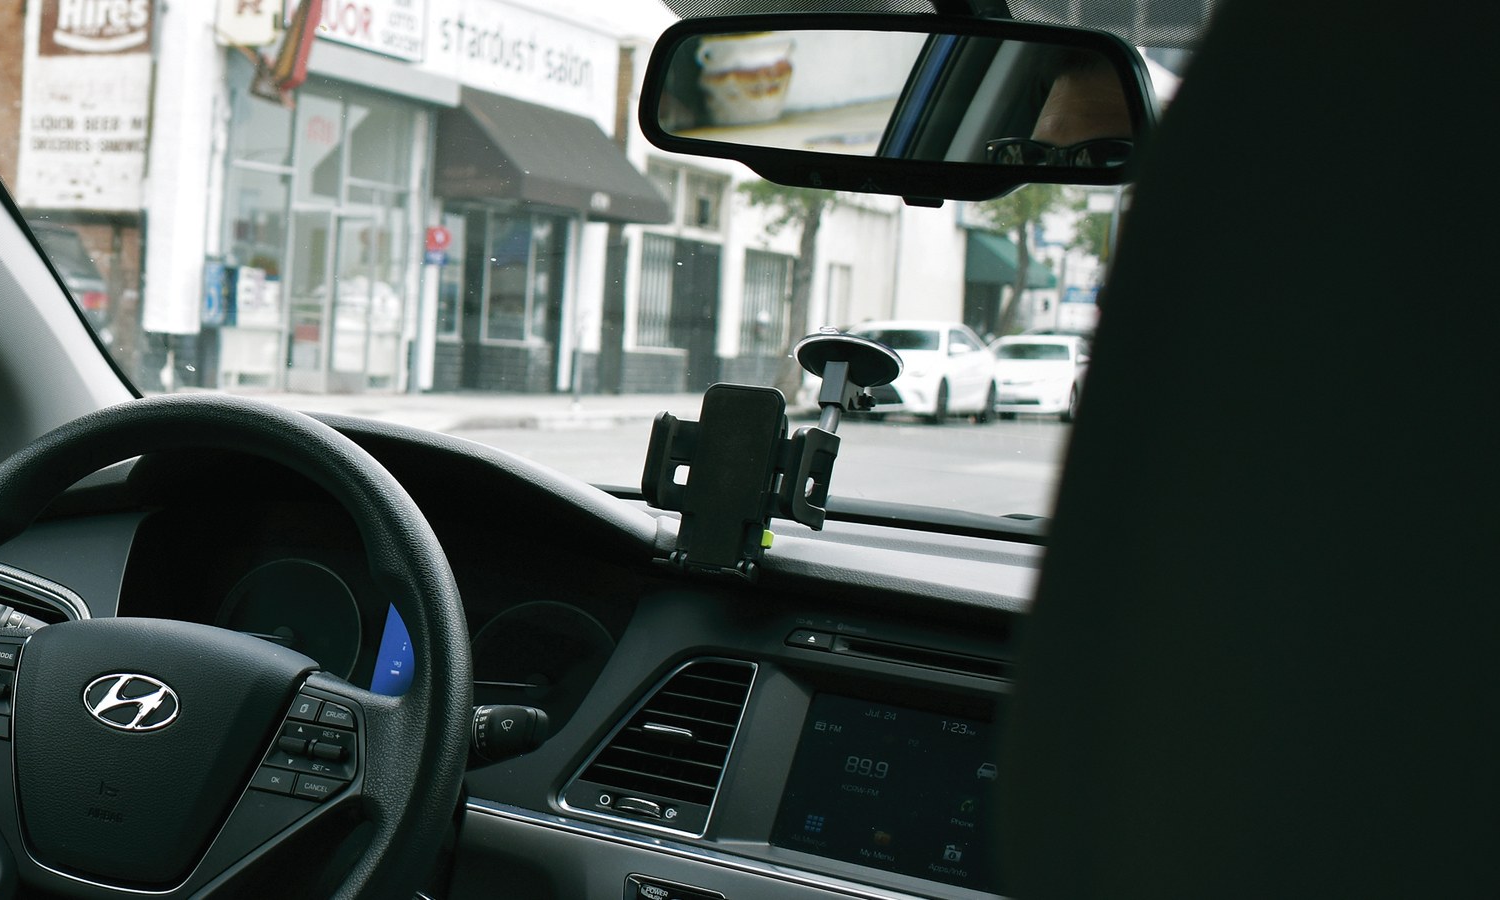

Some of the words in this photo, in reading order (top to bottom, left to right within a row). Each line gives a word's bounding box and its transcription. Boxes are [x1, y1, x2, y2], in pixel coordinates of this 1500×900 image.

[57, 0, 148, 29] Hires
[440, 15, 536, 74] stardust
[544, 46, 594, 94] salon
[326, 710, 348, 720] CRUISE
[884, 712, 897, 720] 24
[829, 725, 842, 733] FM
[845, 756, 889, 779] 89.9
[304, 783, 328, 793] CANCEL
[951, 817, 974, 828] Phone
[874, 852, 895, 862] Menu
[645, 886, 669, 897] POWER
